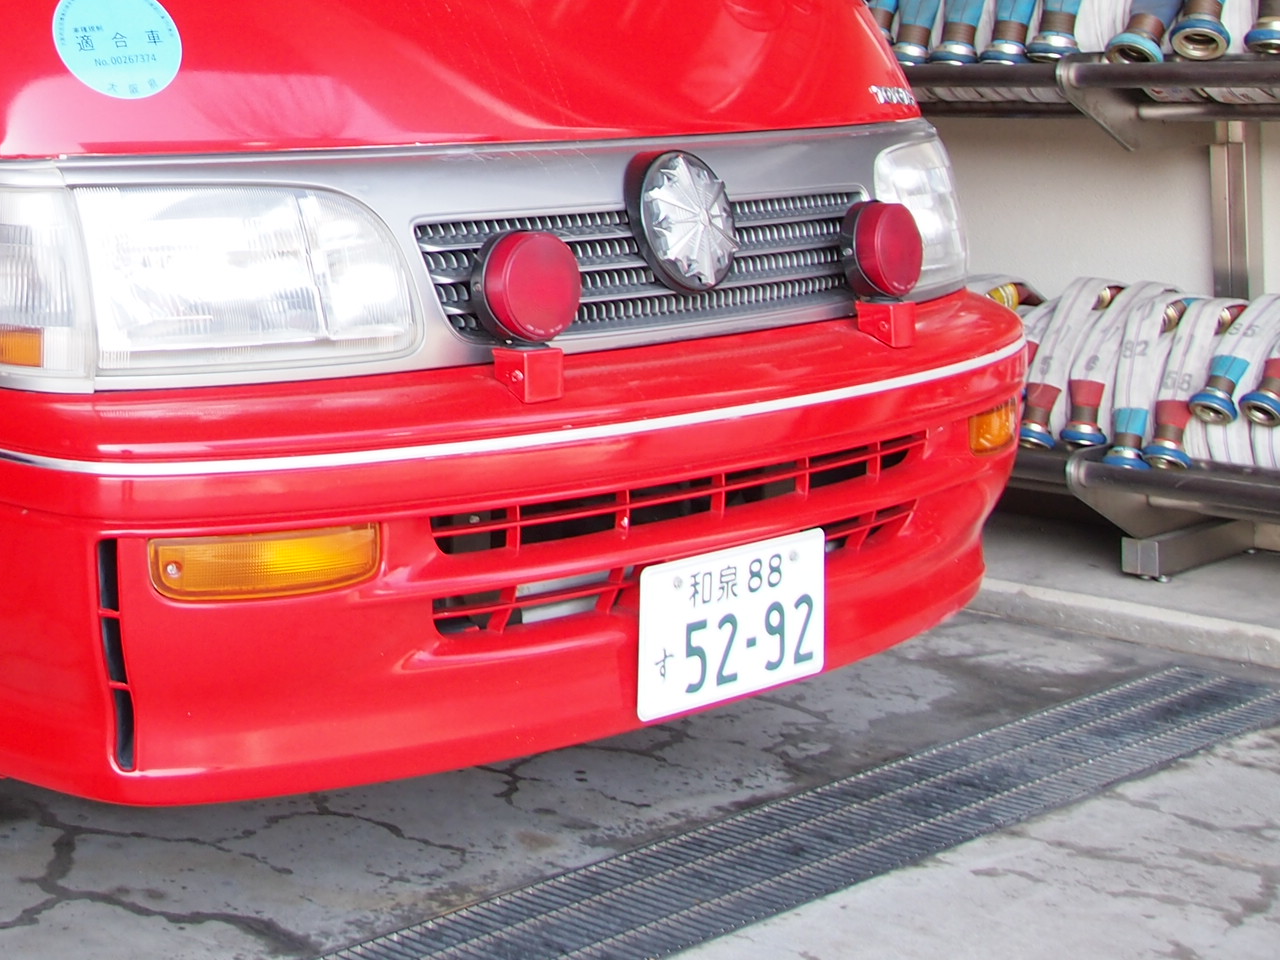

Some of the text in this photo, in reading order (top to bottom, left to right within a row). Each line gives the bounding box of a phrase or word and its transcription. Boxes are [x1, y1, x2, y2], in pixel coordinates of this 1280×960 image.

[1122, 340, 1149, 358] 82
[689, 553, 782, 607] 和泉 88
[655, 593, 813, 694] す 52-92
